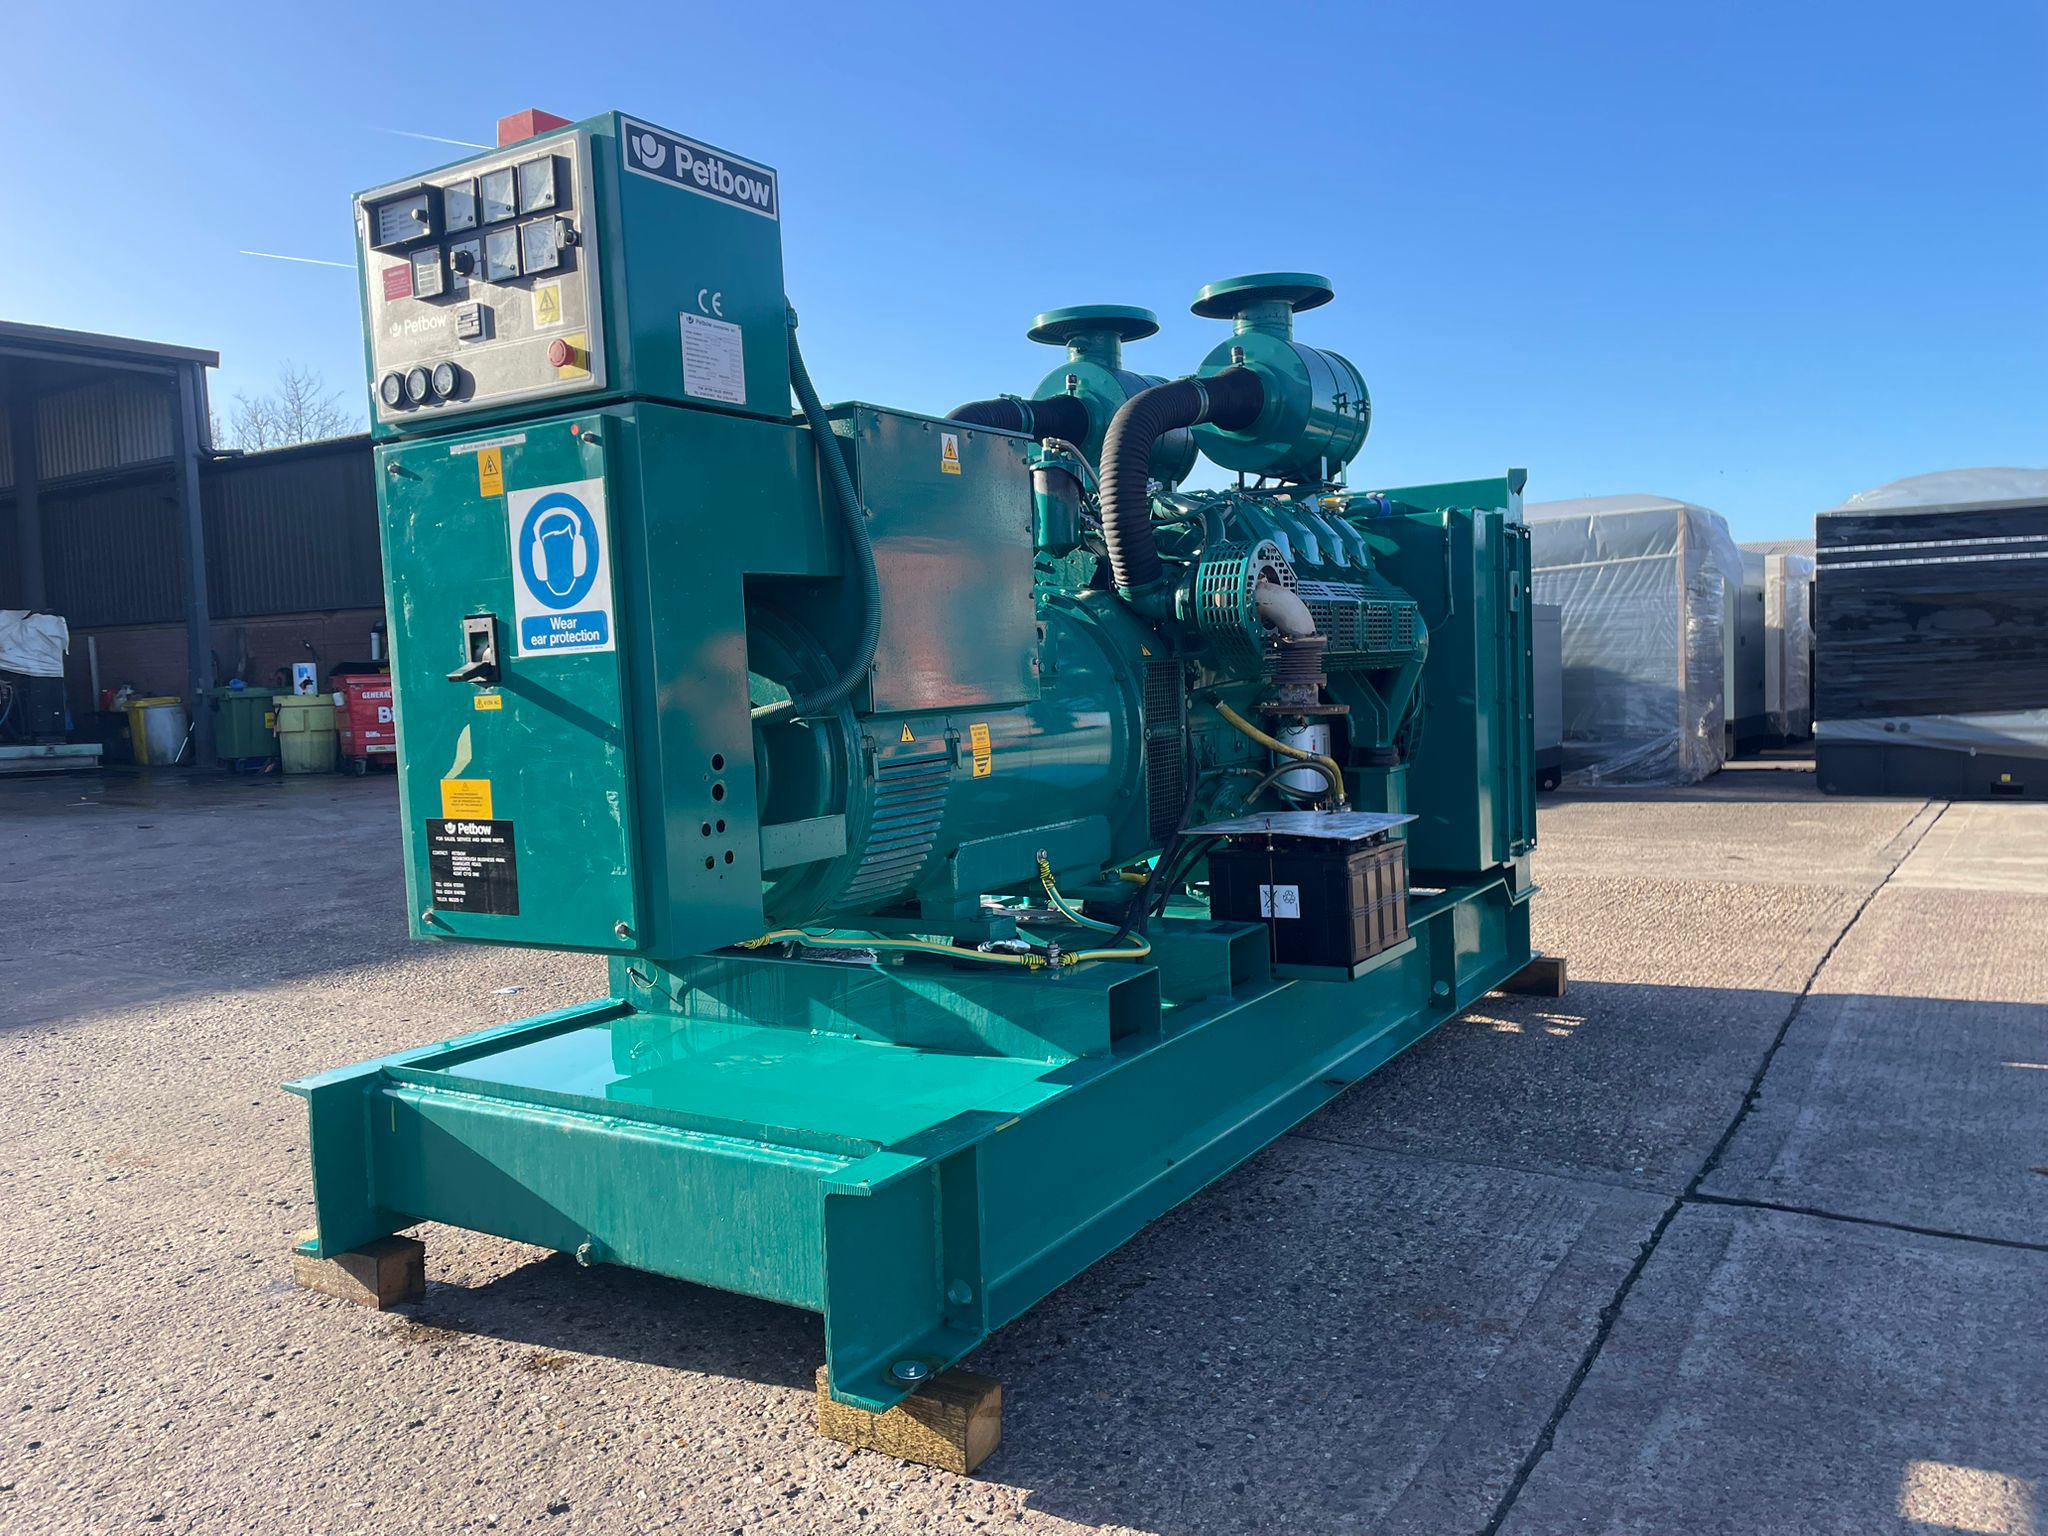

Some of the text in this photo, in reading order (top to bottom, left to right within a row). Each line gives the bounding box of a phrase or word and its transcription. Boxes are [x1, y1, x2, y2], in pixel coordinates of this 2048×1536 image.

[674, 145, 770, 207] Petbow
[404, 314, 447, 335] Petbow
[549, 616, 578, 631] Wear
[530, 629, 600, 647] ear protection
[361, 691, 392, 700] GENERAL
[458, 823, 491, 835] Petbow
